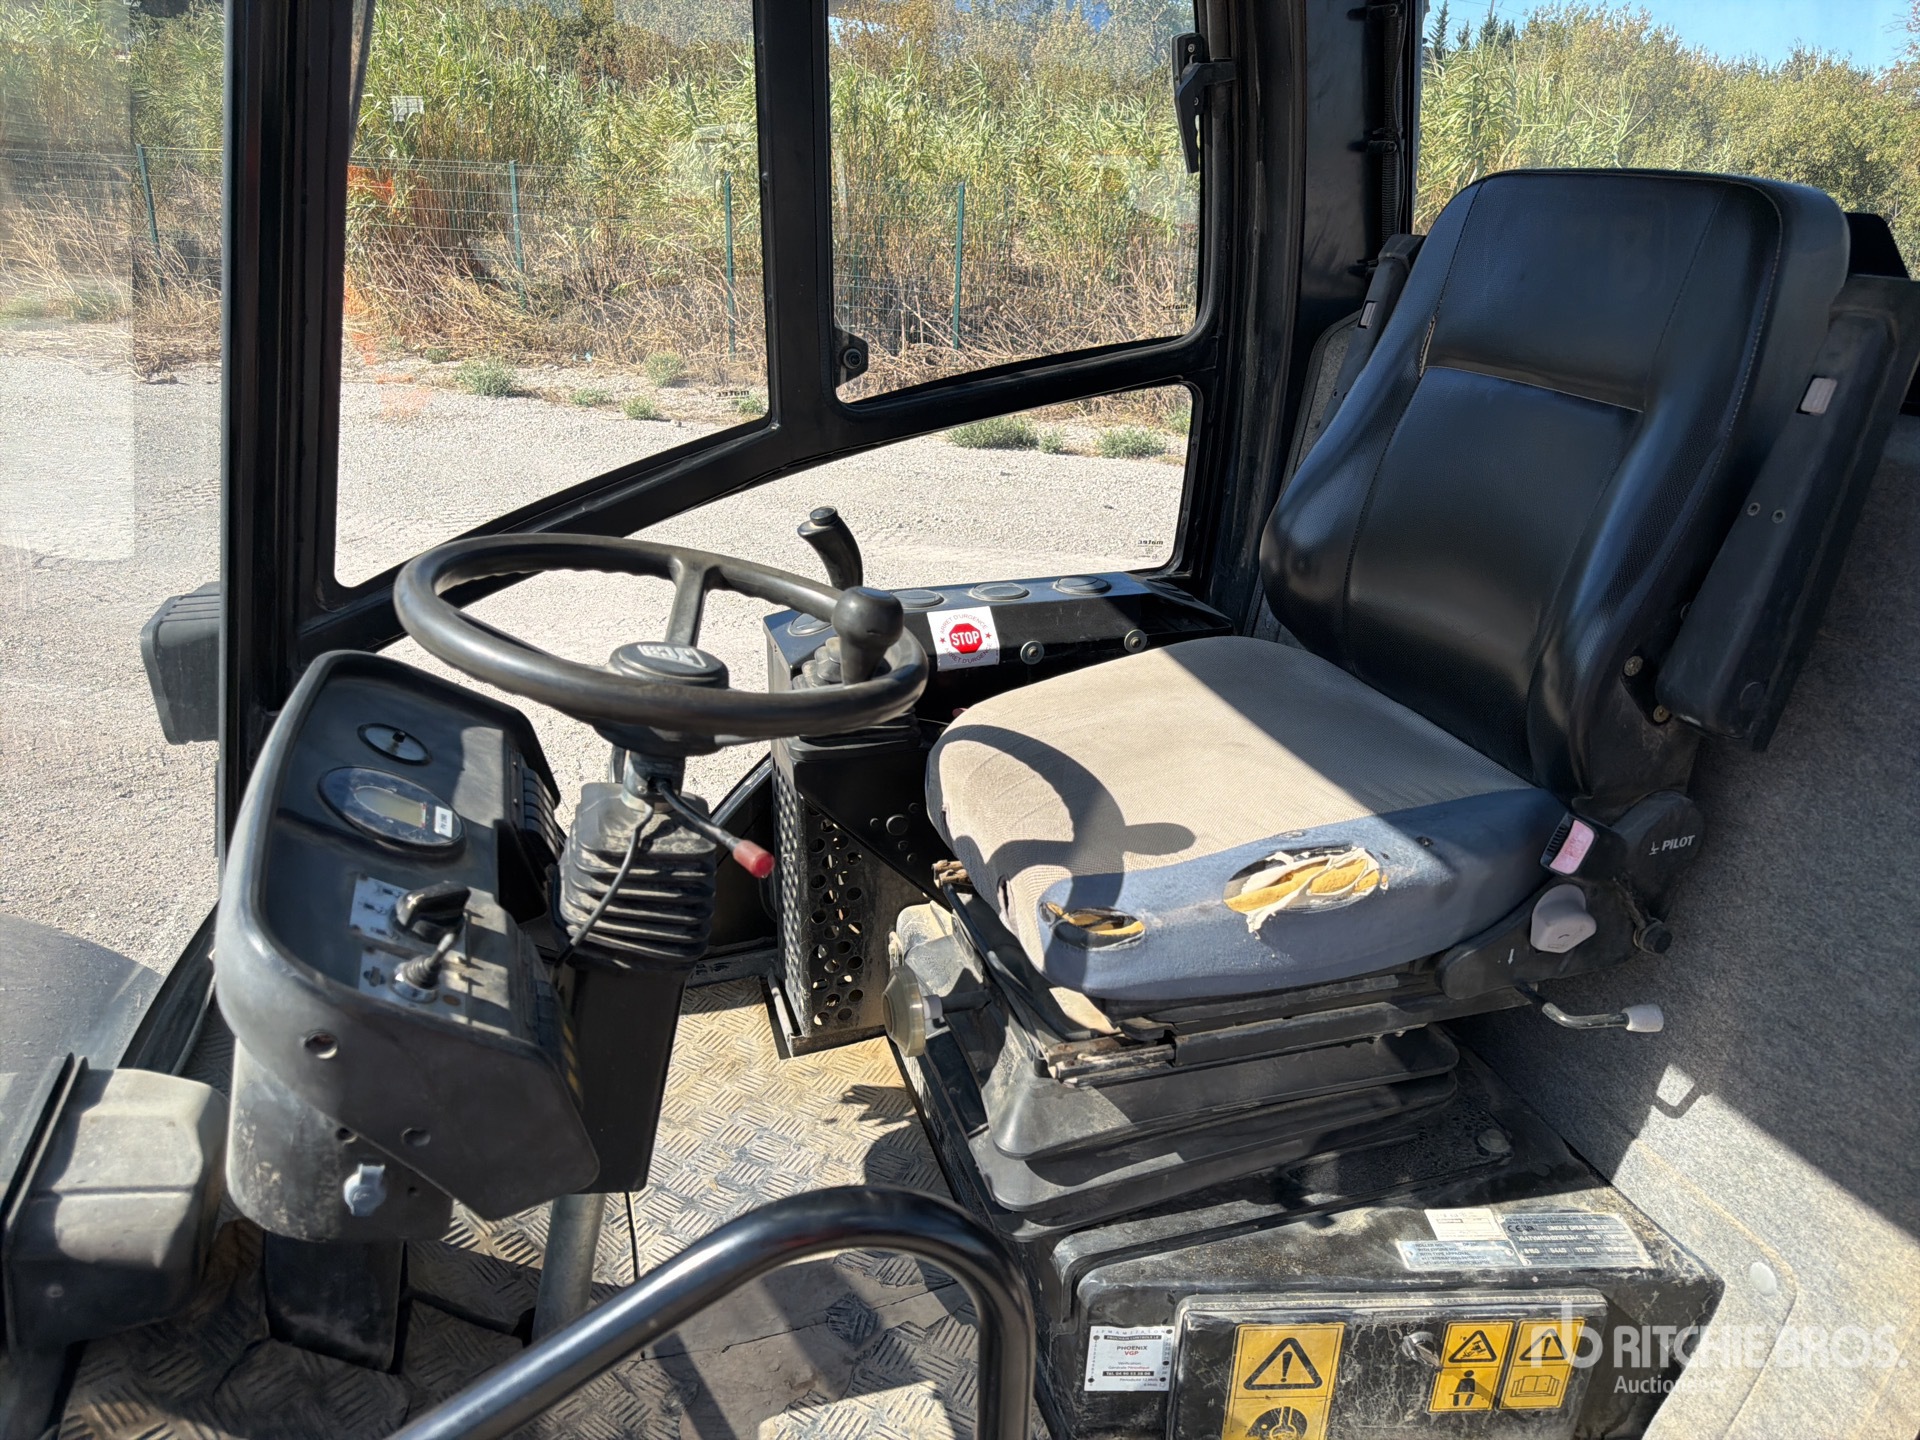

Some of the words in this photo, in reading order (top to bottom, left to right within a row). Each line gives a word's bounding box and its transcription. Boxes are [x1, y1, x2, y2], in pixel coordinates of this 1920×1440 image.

[940, 615, 954, 633] ARRET
[953, 614, 988, 629] D'URGENCE
[951, 631, 980, 646] STOP
[1661, 834, 1696, 851] PILOT
